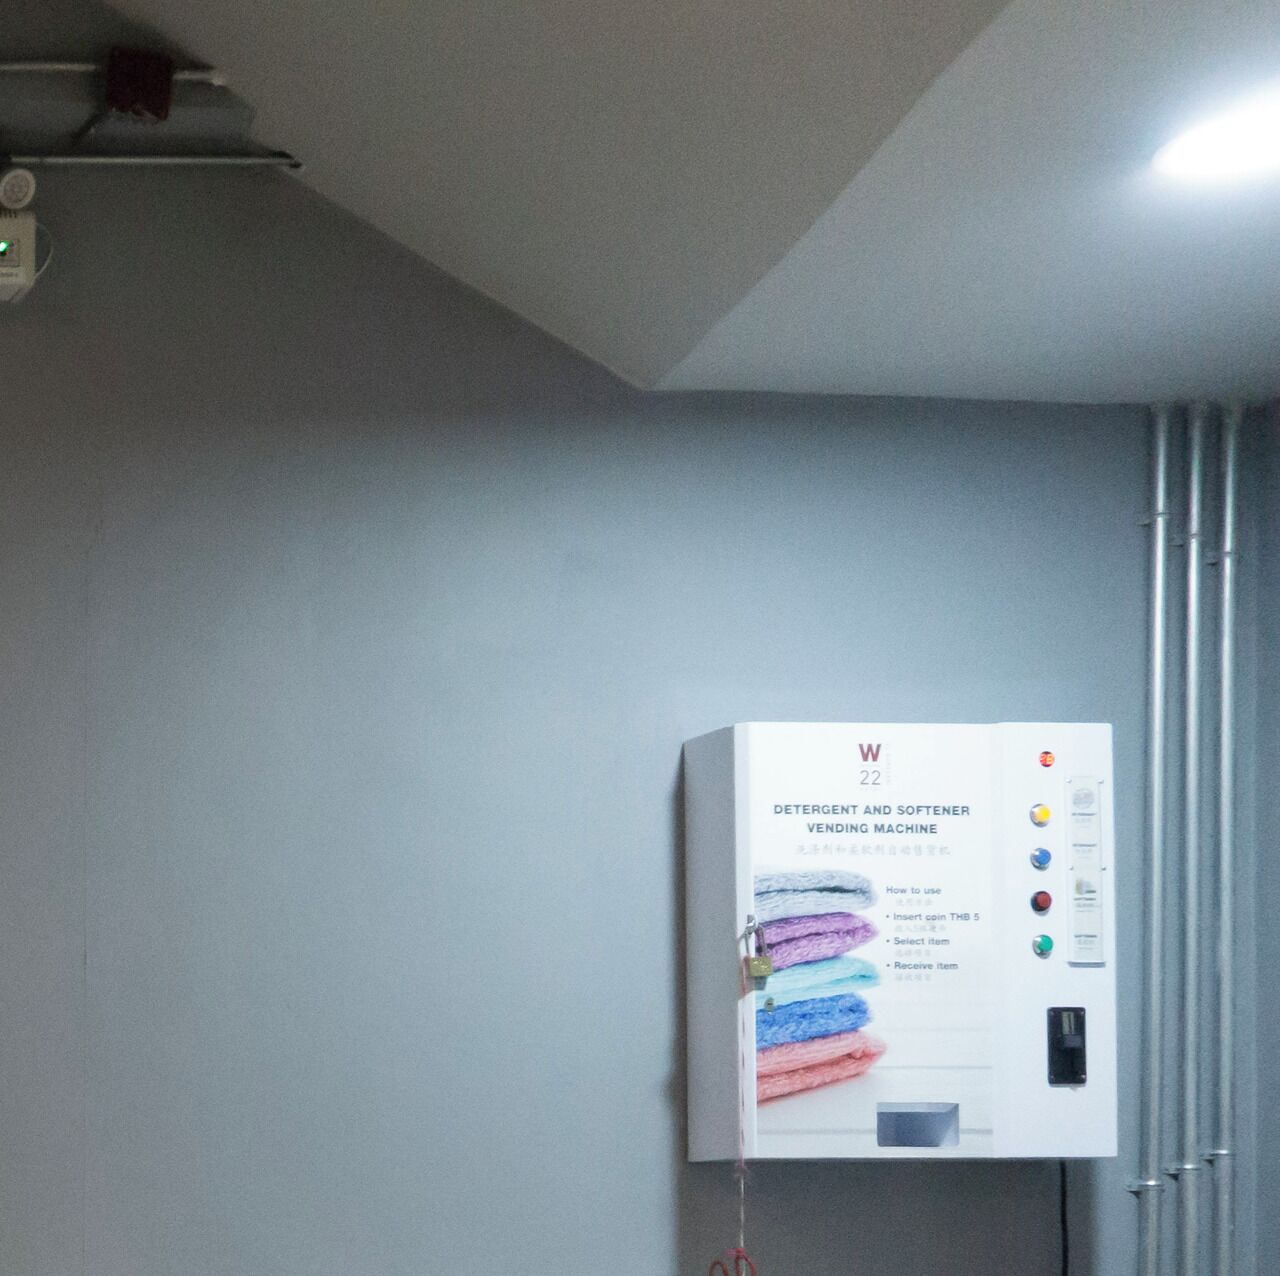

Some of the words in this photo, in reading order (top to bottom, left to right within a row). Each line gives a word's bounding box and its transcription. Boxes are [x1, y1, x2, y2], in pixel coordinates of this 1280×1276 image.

[858, 744, 882, 762] W
[860, 770, 881, 785] 22
[774, 804, 858, 815] DETERGENT
[863, 805, 891, 815] AND
[897, 805, 970, 816] SOFTENER
[807, 823, 868, 833] VENDING
[874, 824, 937, 834] MACHINE
[886, 886, 907, 894] How
[911, 886, 921, 894] to
[893, 913, 922, 921] Insert
[925, 913, 946, 921] coin
[950, 913, 970, 921] THB
[974, 913, 980, 921] 5
[894, 937, 925, 945] Select
[928, 937, 950, 945] item
[894, 961, 933, 970] Receive
[936, 962, 958, 970] item
